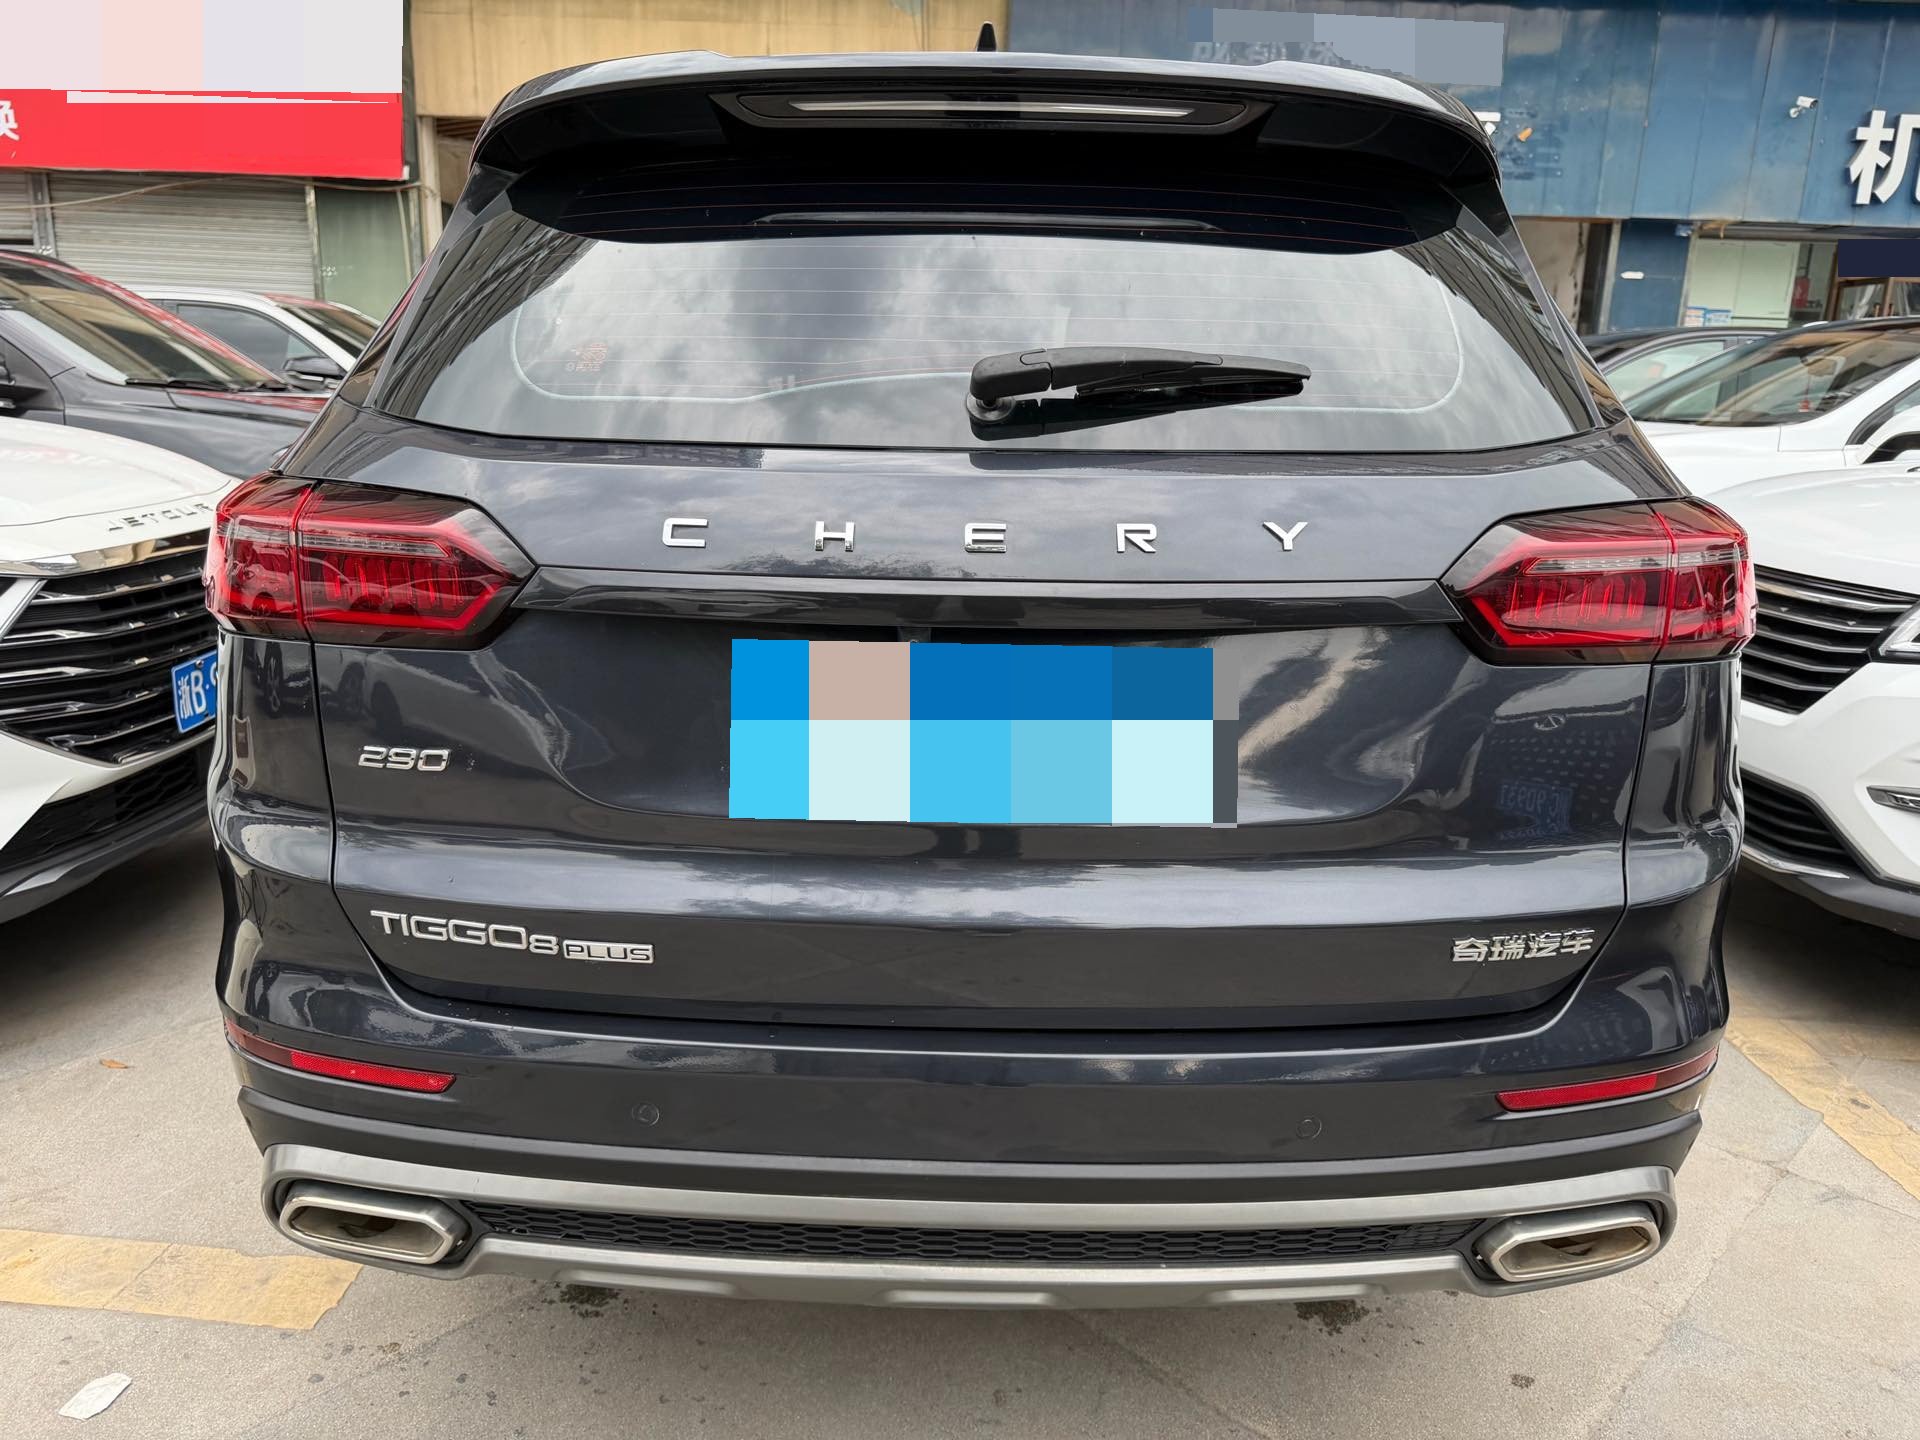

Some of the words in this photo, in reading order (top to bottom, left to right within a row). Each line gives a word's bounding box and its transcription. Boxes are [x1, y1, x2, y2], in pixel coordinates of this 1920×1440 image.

[107, 502, 213, 532] JETOUR
[661, 516, 1309, 554] CHERY
[358, 744, 450, 772] 290
[1452, 928, 1596, 963] 奇瑞汽车
